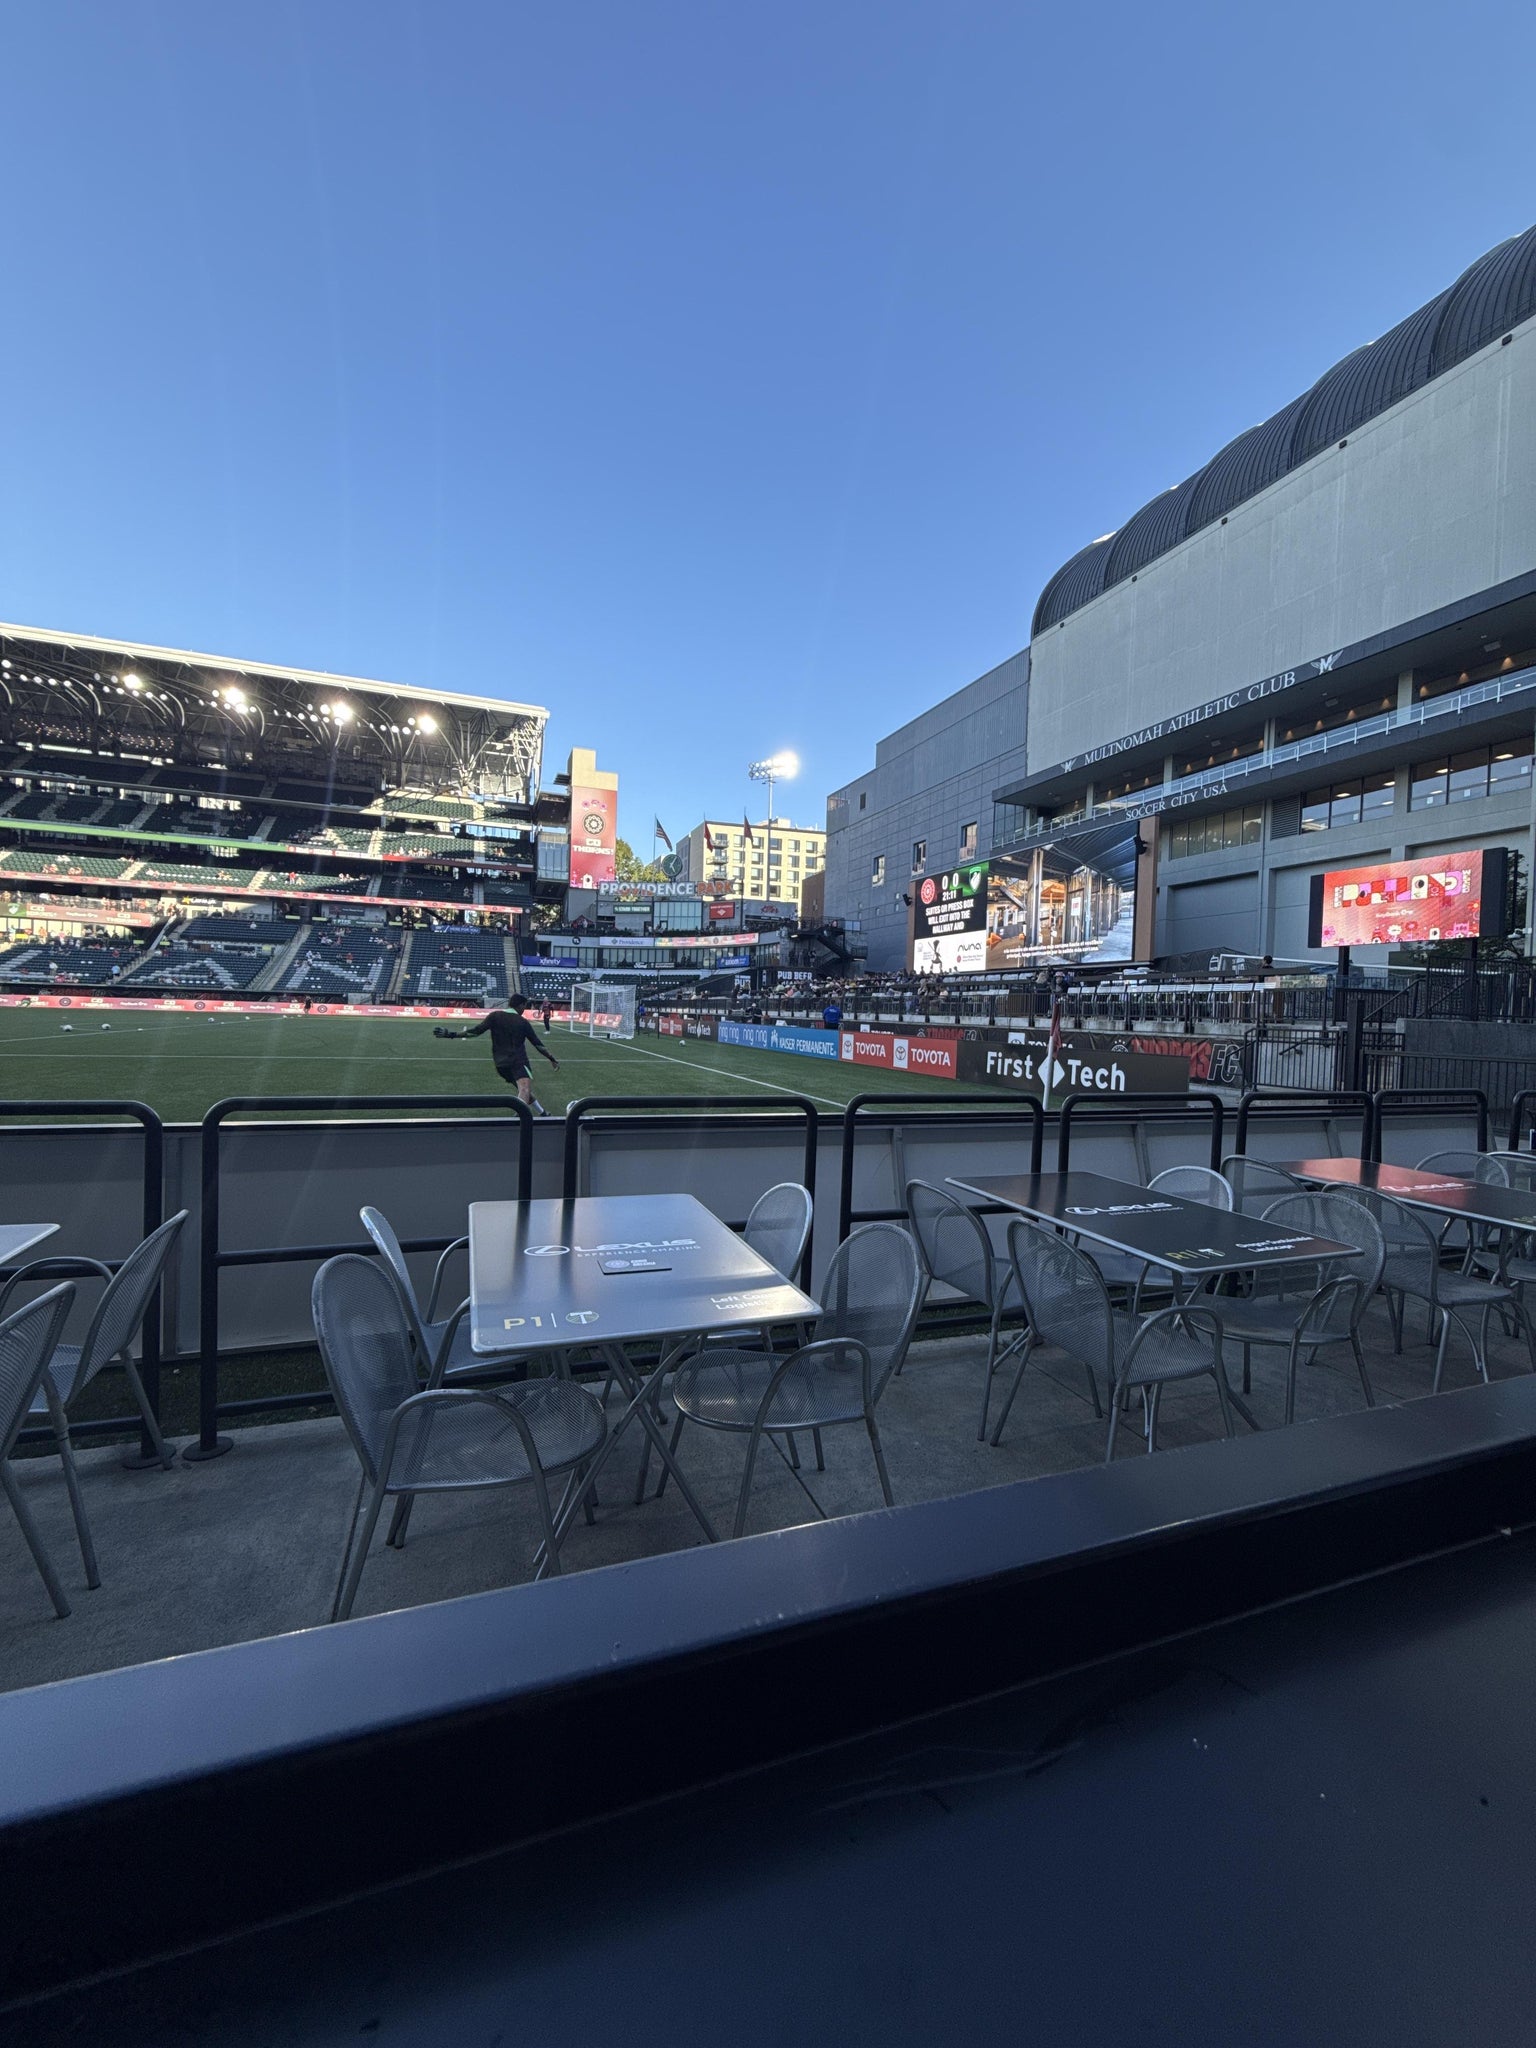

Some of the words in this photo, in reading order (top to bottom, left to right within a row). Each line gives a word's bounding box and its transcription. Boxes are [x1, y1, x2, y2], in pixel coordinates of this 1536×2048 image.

[1084, 724, 1163, 765] MULTNOMAH
[1167, 692, 1240, 733] ATHLETIC
[1247, 671, 1296, 701] CLUB
[1126, 801, 1166, 820] SOCCER
[1171, 791, 1198, 808] CITY
[1203, 783, 1228, 799] USA
[600, 881, 695, 896] PROVIDENCE
[696, 881, 734, 896] PARK
[941, 875, 949, 890] 0
[952, 872, 960, 888] 0
[779, 1037, 796, 1050] KAISER
[796, 1038, 834, 1056] PERMANENTE
[855, 1042, 886, 1058] TOYOTA
[911, 1048, 951, 1067] TOYOTA
[986, 1051, 1033, 1080] First
[1067, 1059, 1126, 1092] Tech
[1094, 1202, 1173, 1213] LEXUS
[574, 1238, 697, 1252] LEXUS
[577, 1249, 648, 1258] EXPERIENCE
[651, 1245, 702, 1253] AMAZING
[710, 1295, 740, 1303] Left
[504, 1315, 542, 1330] P1
